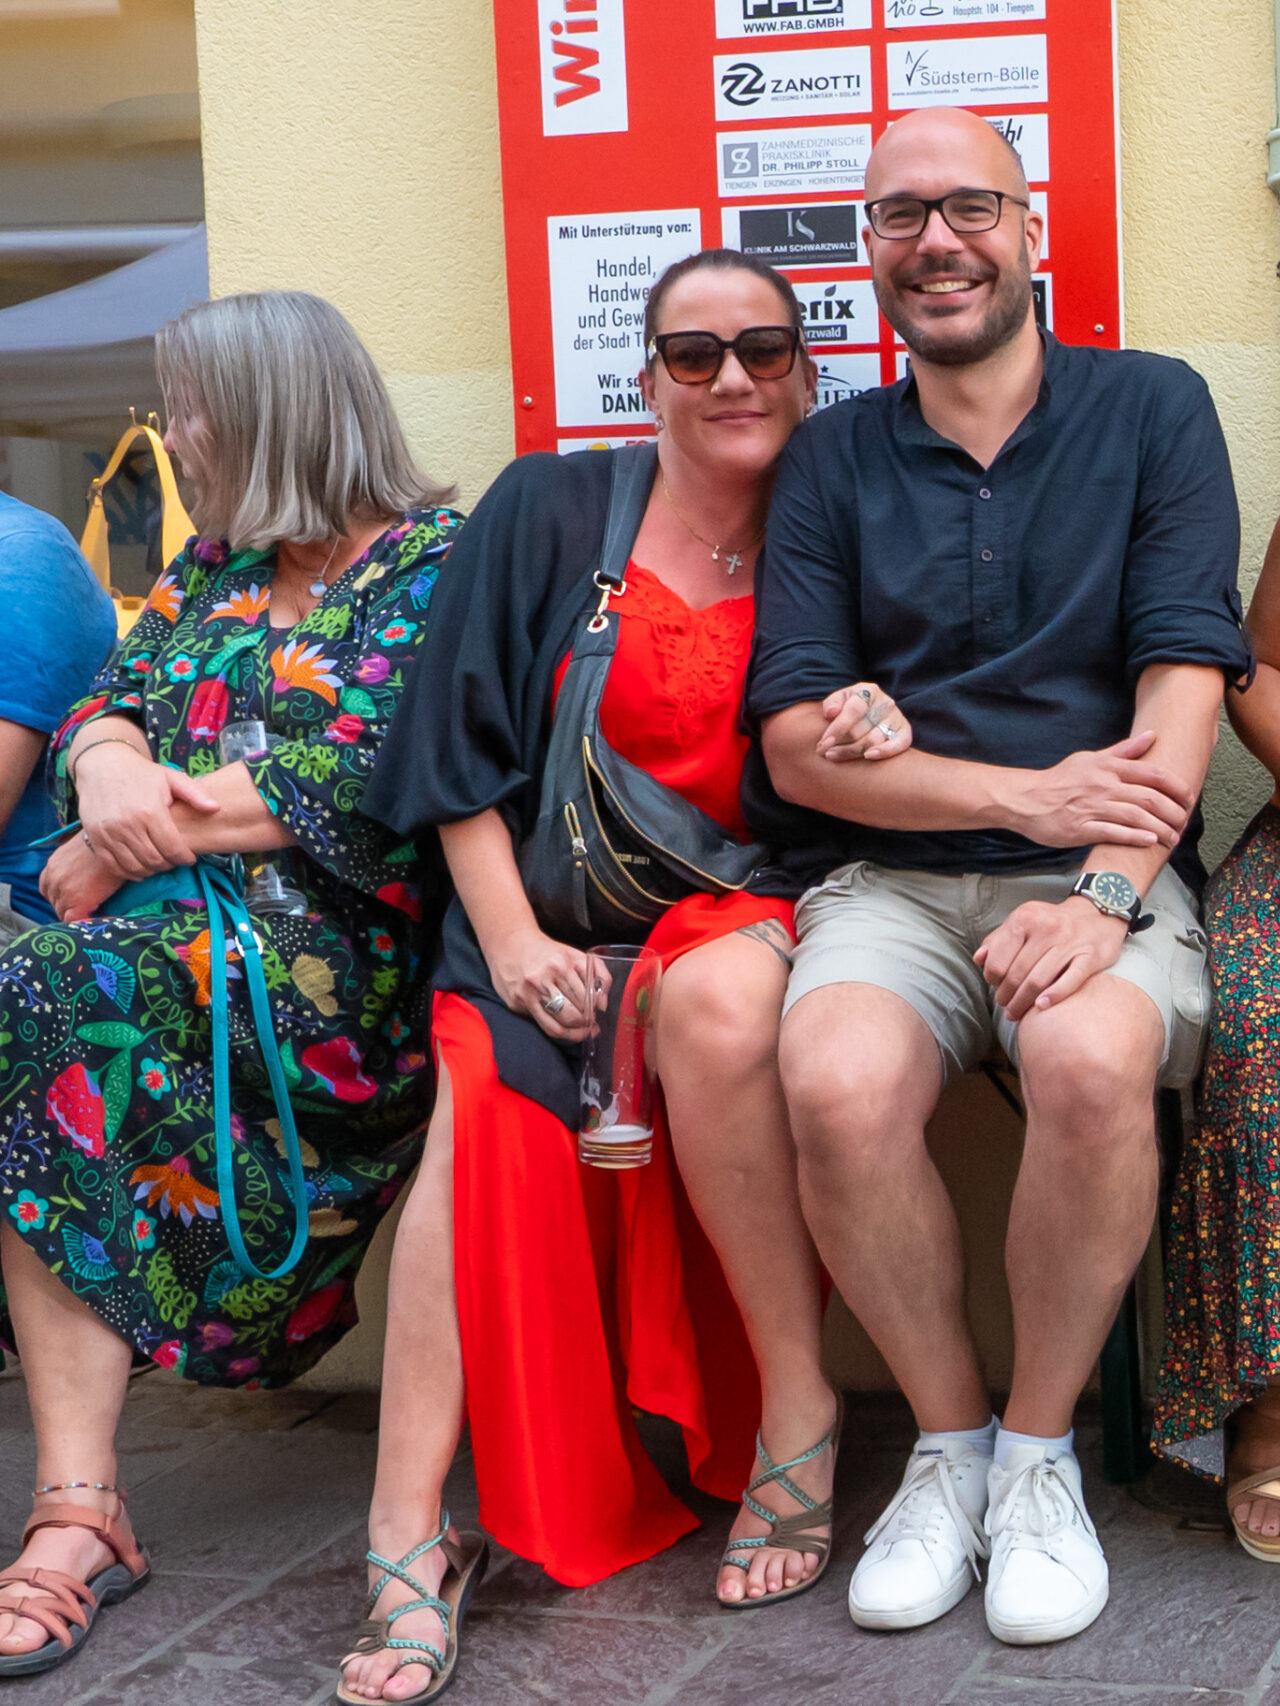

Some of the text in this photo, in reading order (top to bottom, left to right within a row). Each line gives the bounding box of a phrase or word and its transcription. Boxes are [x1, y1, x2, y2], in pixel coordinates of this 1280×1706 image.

[987, 4, 999, 14] 104
[743, 17, 844, 34] WWW.FAB.GMBH
[771, 75, 861, 93] ZANOTTI
[920, 67, 1040, 86] Südstern-Bölle
[761, 136, 865, 150] ZAHNMEDIZINISCHE
[762, 150, 831, 161] PRAXISKLINIK
[762, 159, 859, 172] DR. PHILIPP STOLL
[725, 181, 757, 190] TIENGEN
[559, 223, 692, 239] Mit Unterstützung von:
[744, 241, 857, 254] KLINIK AM SCHWARZWALD
[597, 255, 657, 278] Handel,
[589, 281, 650, 303] Handwe
[798, 299, 855, 320] erix
[578, 307, 645, 329] und Gew
[573, 331, 643, 350] der Stadt T
[806, 326, 841, 340] rzwald
[597, 374, 621, 389] Wir
